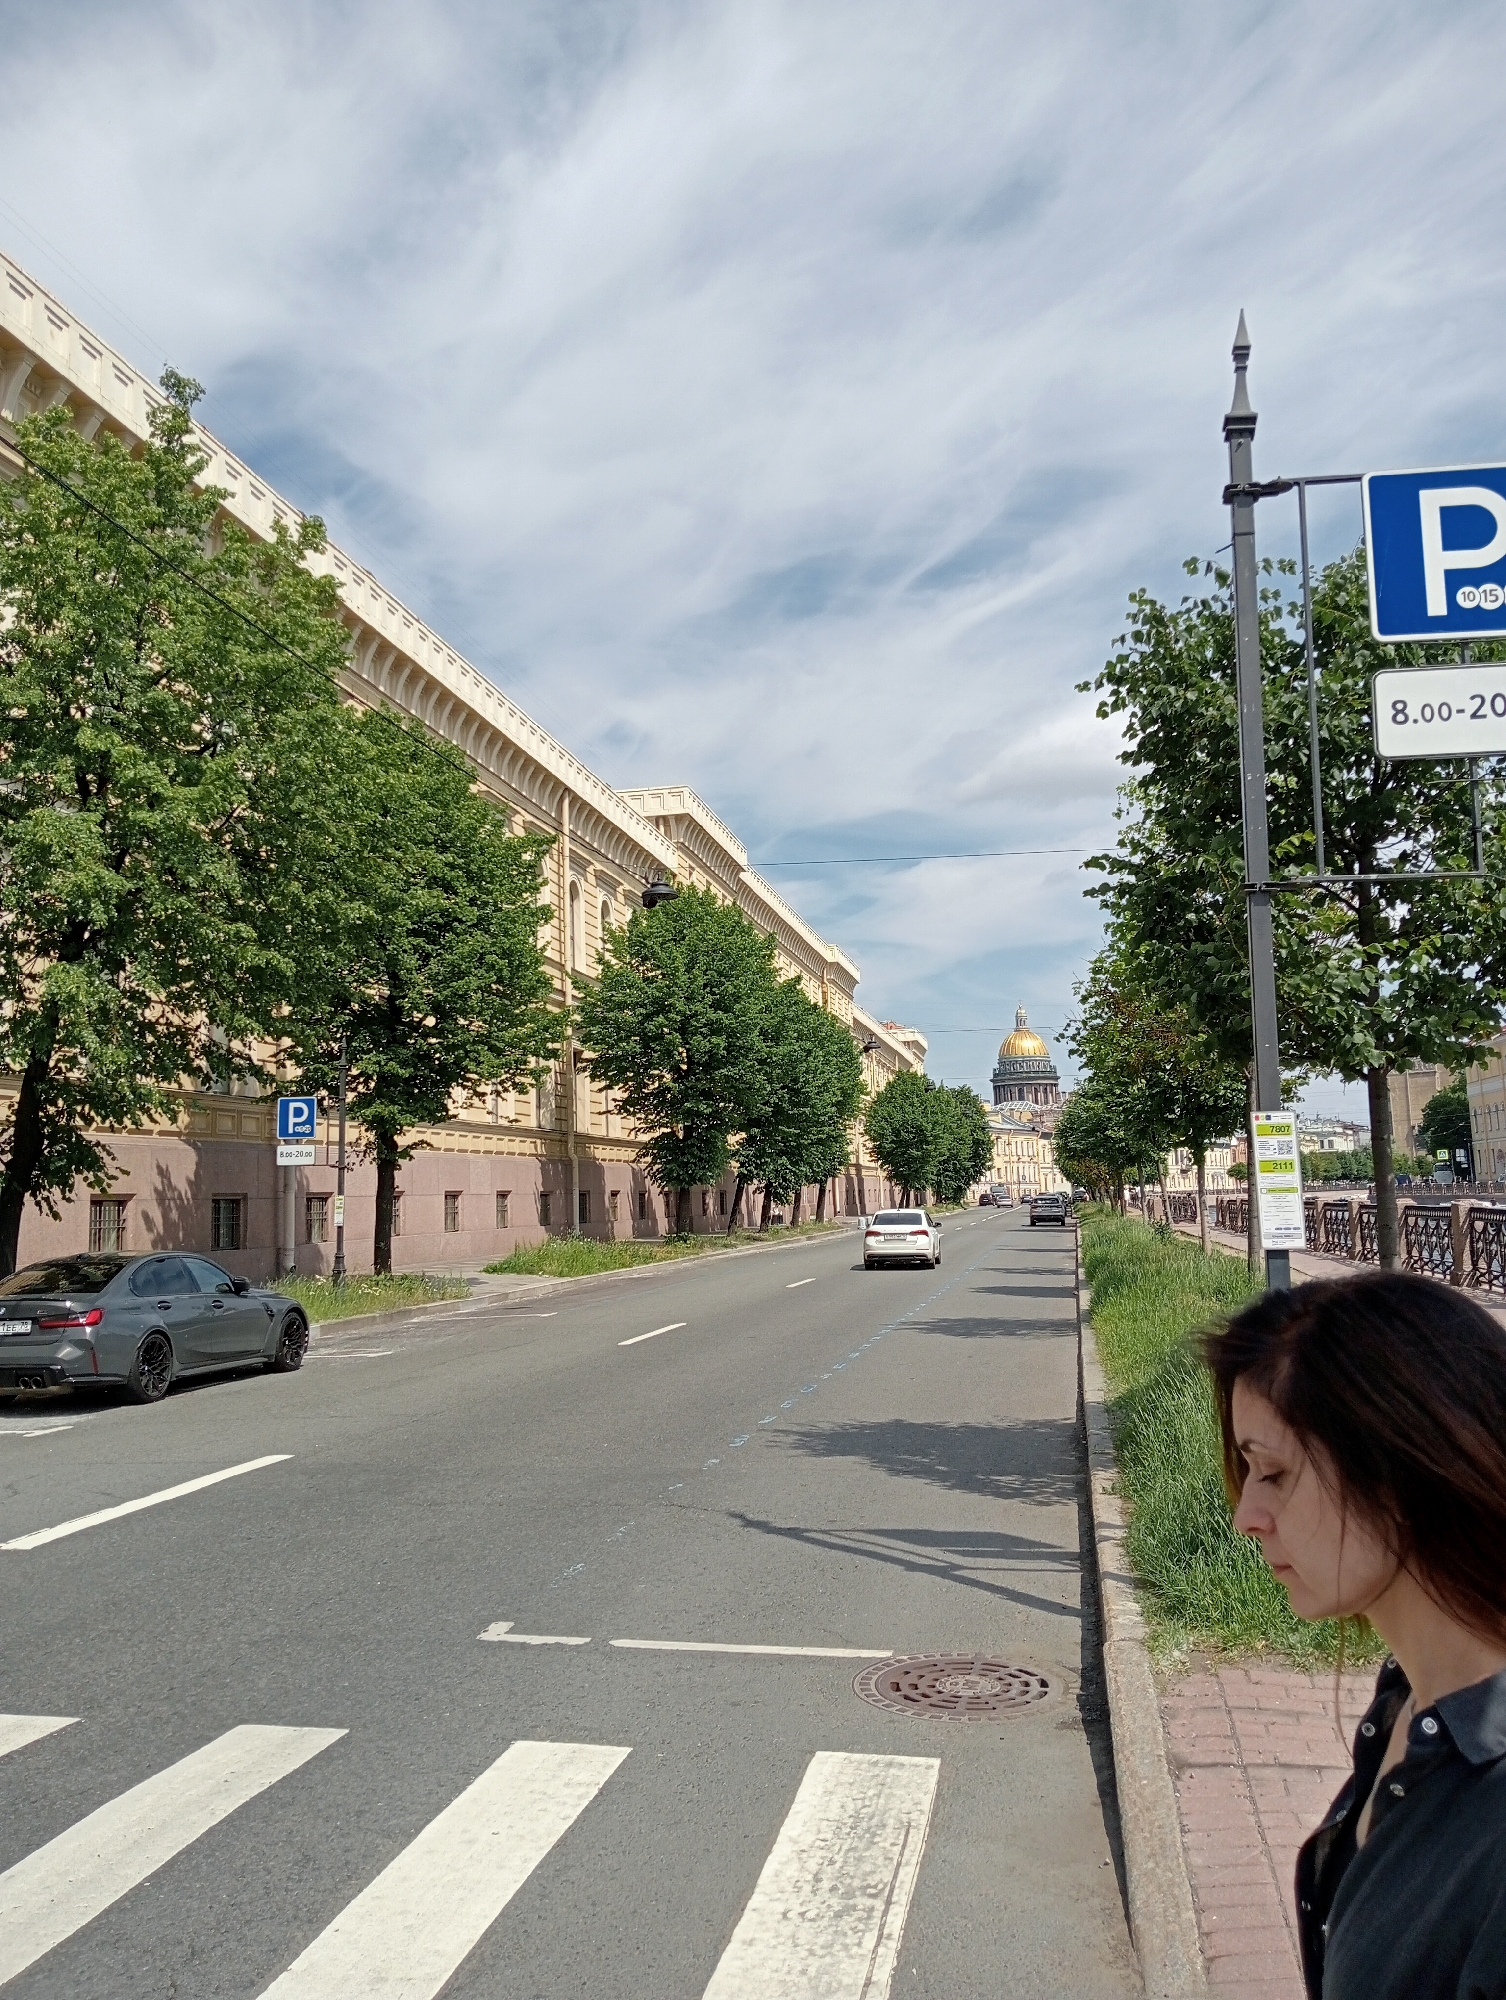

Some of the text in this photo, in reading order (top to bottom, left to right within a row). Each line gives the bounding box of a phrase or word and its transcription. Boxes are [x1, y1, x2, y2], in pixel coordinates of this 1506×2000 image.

[1418, 486, 1506, 617] P
[1460, 588, 1499, 603] 10 15
[288, 1102, 309, 1133] P
[1269, 1125, 1291, 1133] 7807
[1272, 1161, 1293, 1170] 2111
